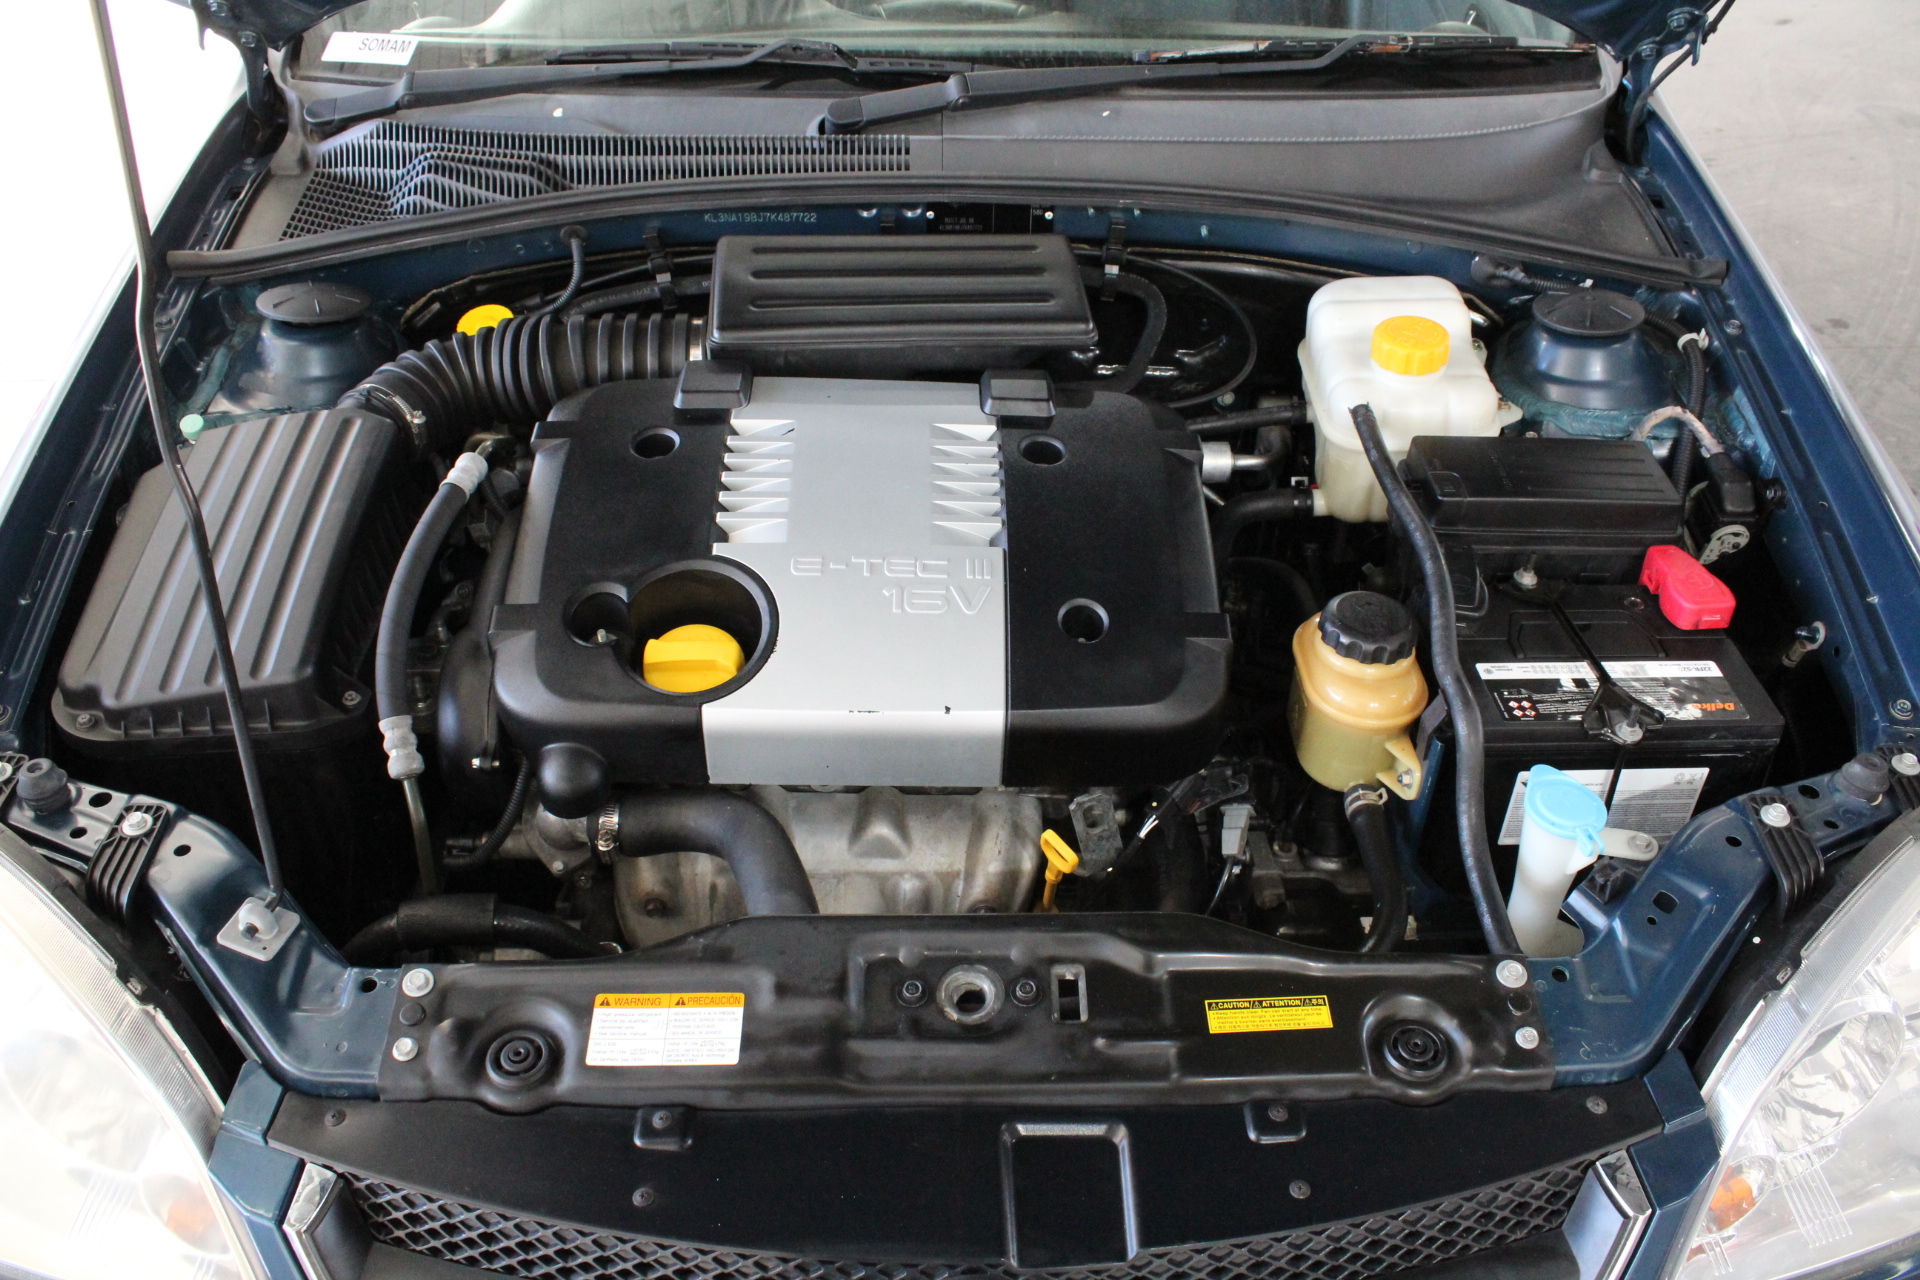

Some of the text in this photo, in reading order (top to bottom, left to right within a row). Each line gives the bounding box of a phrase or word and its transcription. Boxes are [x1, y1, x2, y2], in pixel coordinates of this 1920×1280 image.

[358, 38, 412, 52] SOMAM
[790, 556, 992, 579] E-TEC III
[882, 585, 992, 614] 16V
[1687, 702, 1736, 711] Delko
[614, 998, 661, 1006] WARNING
[688, 994, 741, 1005] PRECAUCIÓN
